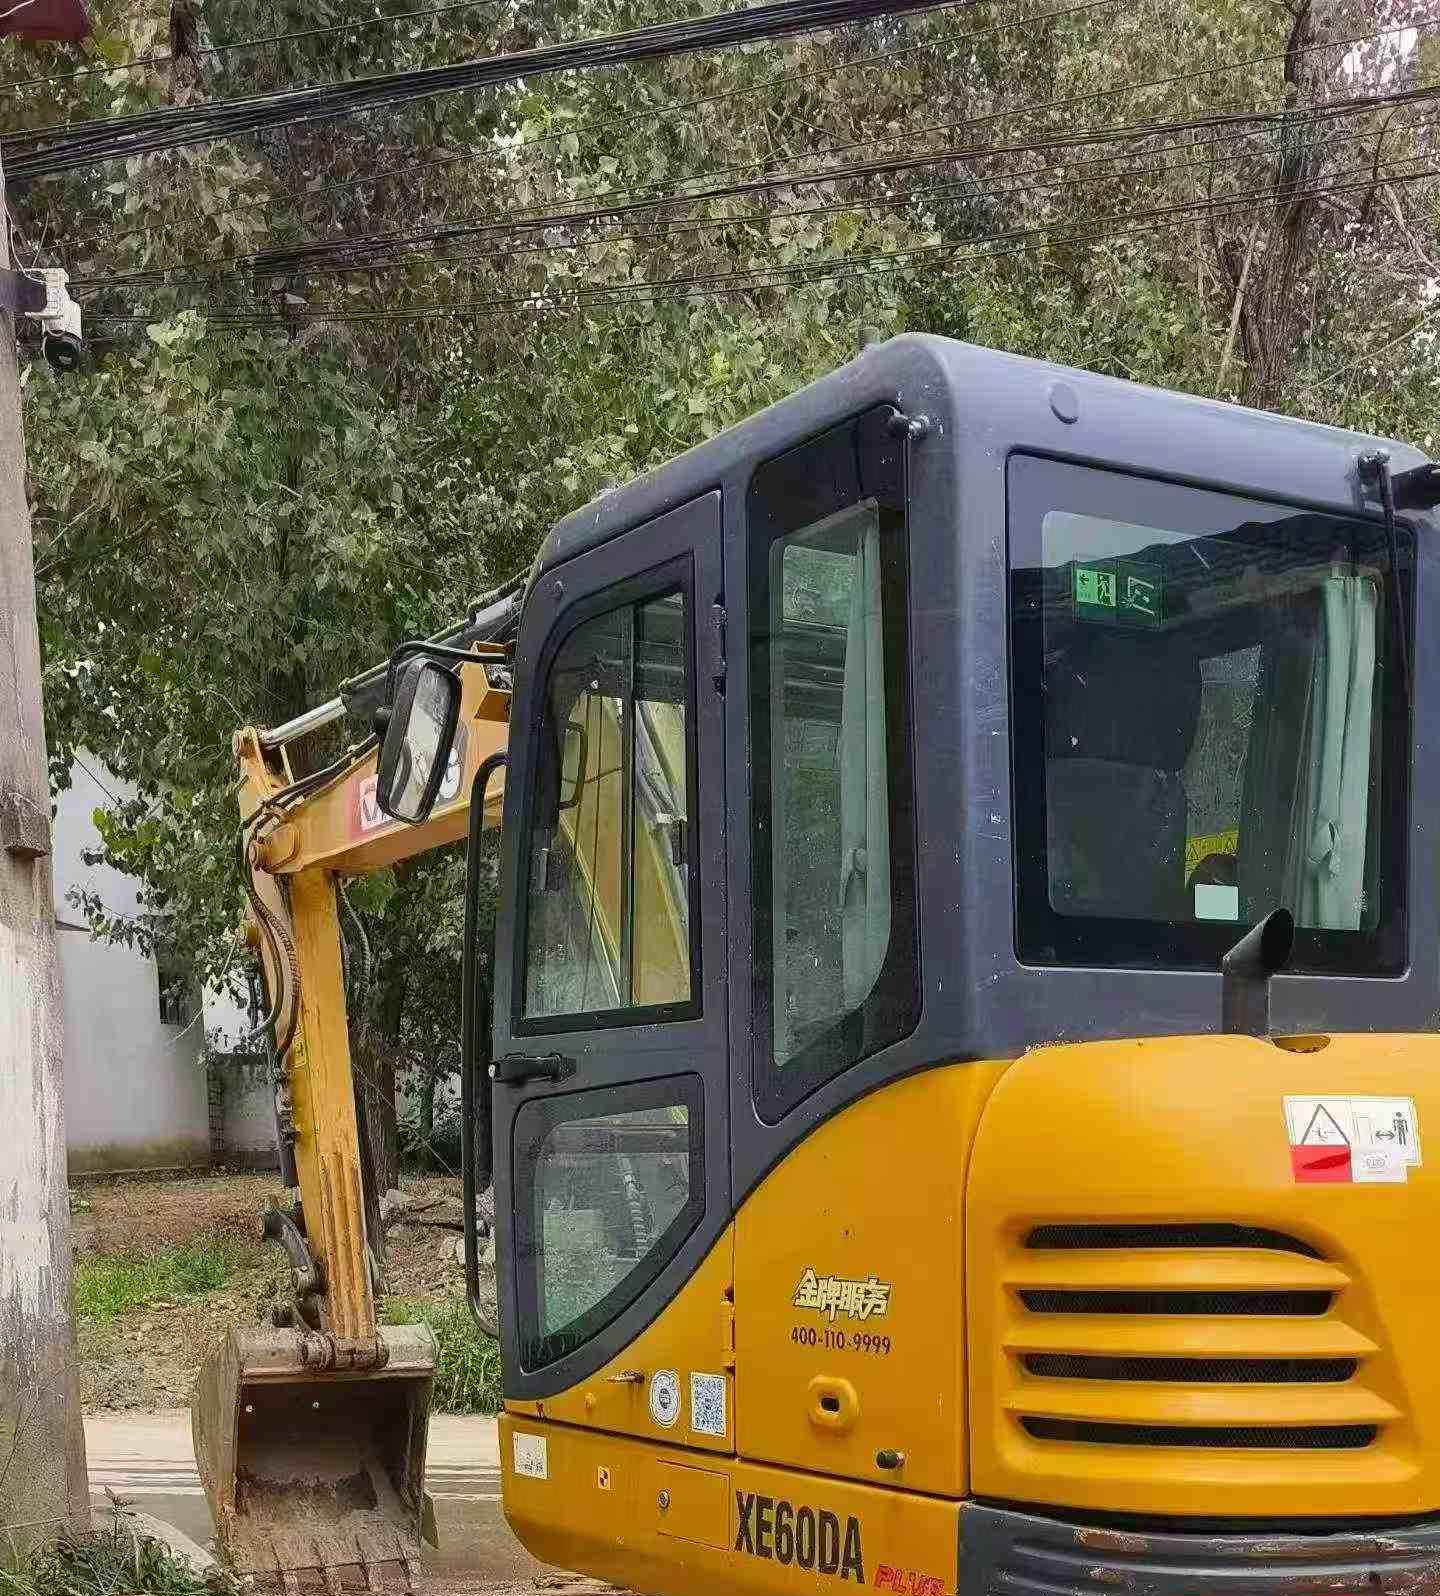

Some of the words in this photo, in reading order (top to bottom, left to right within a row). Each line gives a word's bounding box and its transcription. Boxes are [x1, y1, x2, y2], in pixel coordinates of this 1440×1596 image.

[794, 1267, 891, 1322] 金牌服务
[791, 1327, 891, 1354] 400-110-9999
[735, 1490, 865, 1584] XE60DA
